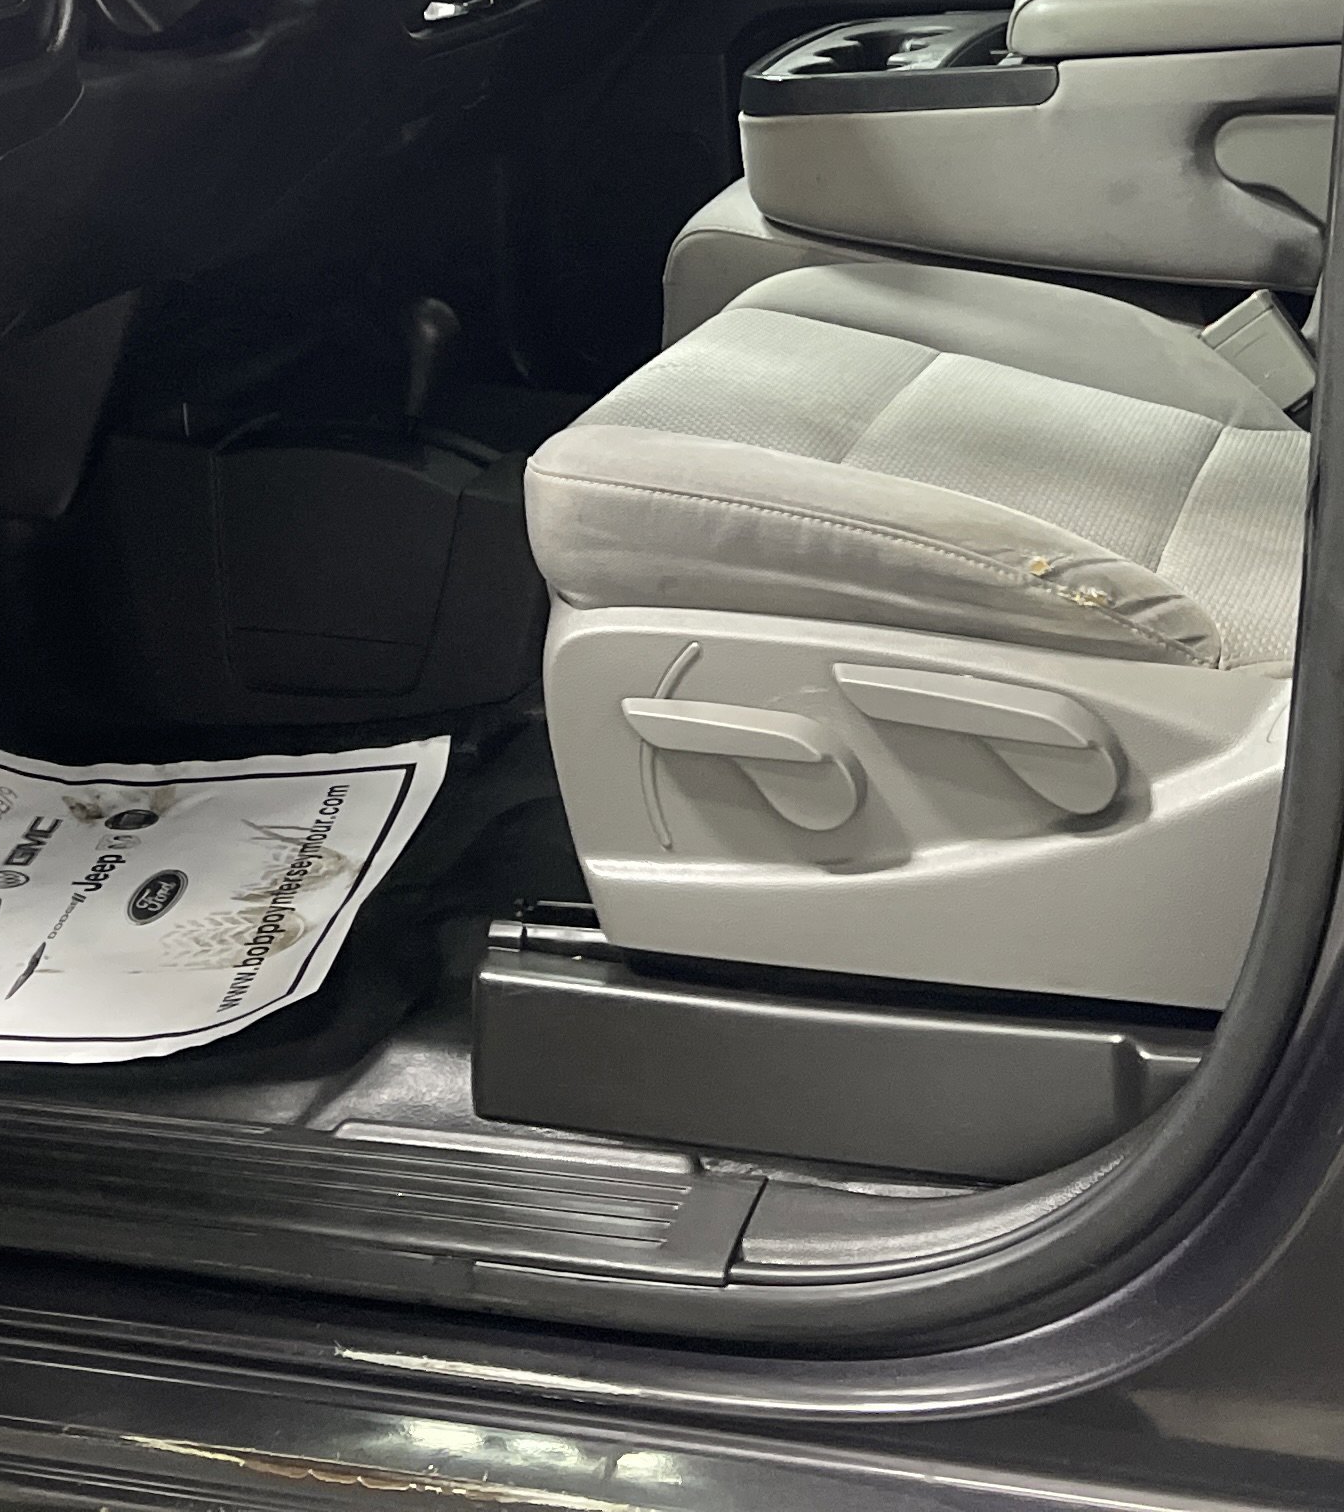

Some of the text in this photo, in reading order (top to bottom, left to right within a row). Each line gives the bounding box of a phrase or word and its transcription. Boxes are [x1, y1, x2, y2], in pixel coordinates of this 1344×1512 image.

[3, 815, 64, 867] GMC
[71, 853, 127, 893] Jeep
[134, 880, 177, 913] Ford
[215, 783, 351, 1014] www.bobpoynterseymour.com
